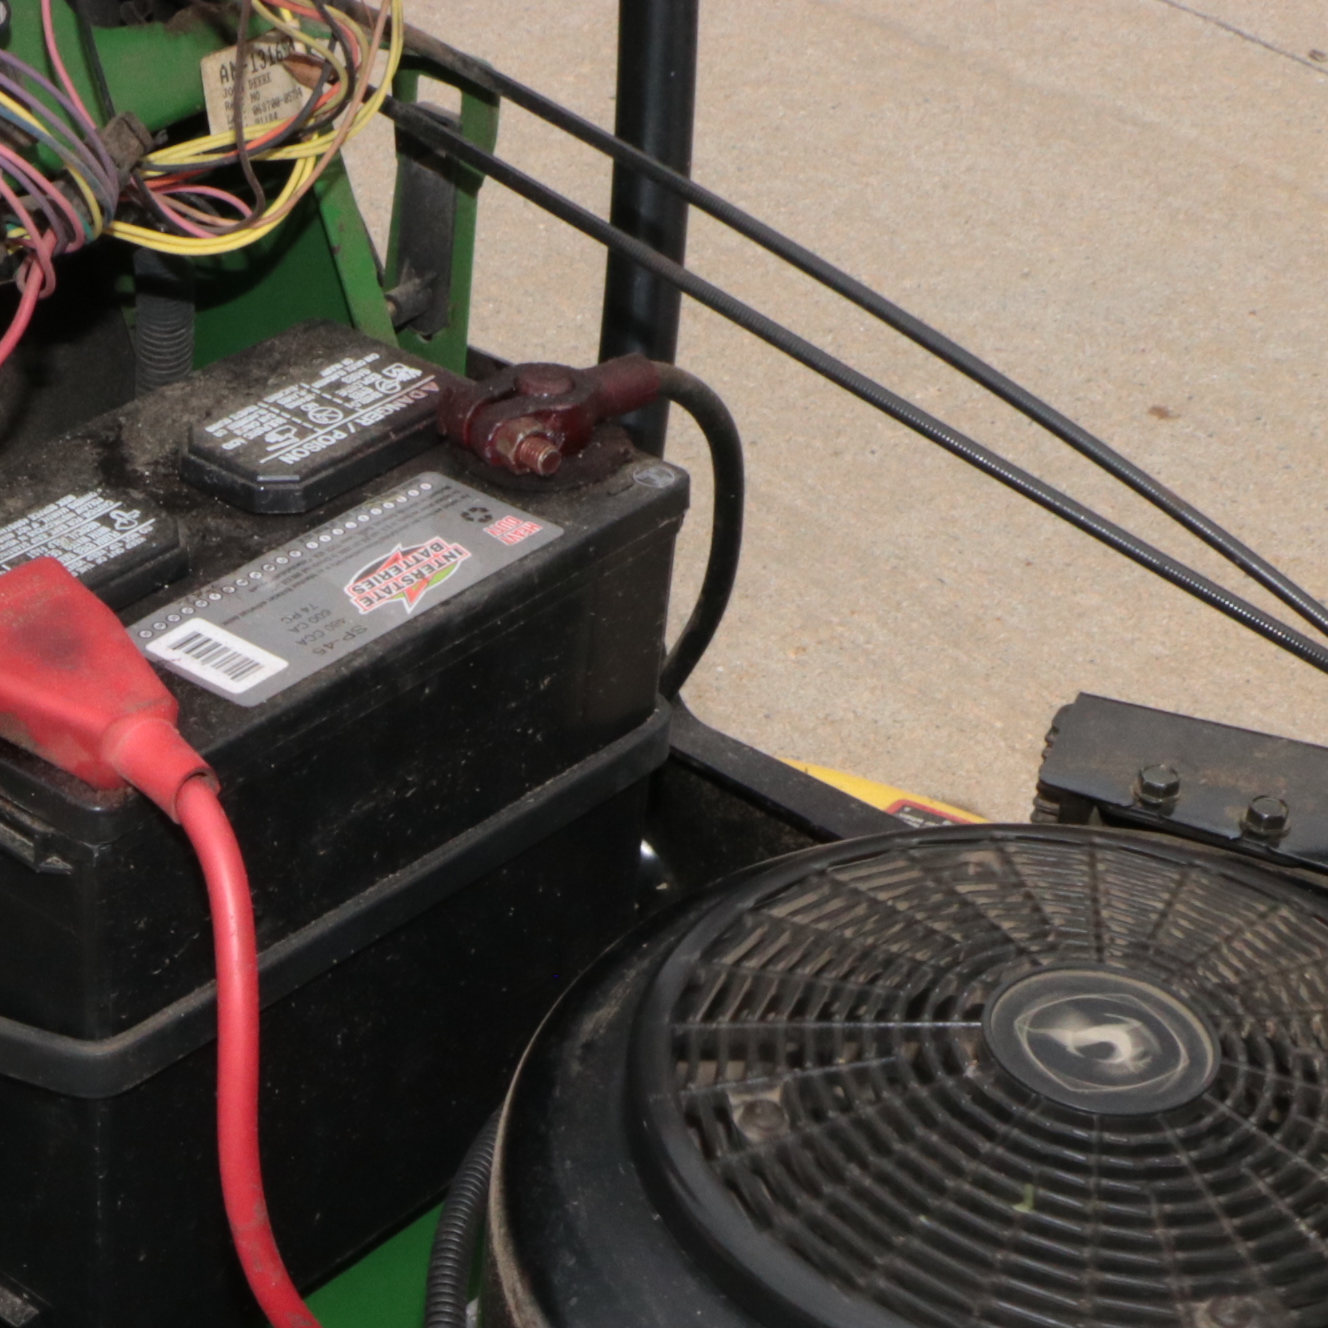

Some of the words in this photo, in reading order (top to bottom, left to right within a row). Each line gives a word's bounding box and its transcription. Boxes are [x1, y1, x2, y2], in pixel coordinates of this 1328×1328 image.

[353, 388, 430, 427] DANGER
[276, 427, 349, 465] POISON
[483, 515, 522, 535] DUTY
[503, 521, 543, 545] HEAVY
[349, 542, 447, 594] BATTERIES
[357, 547, 469, 608] INTERSTATE
[286, 621, 309, 634] CA
[294, 629, 325, 646] CCA
